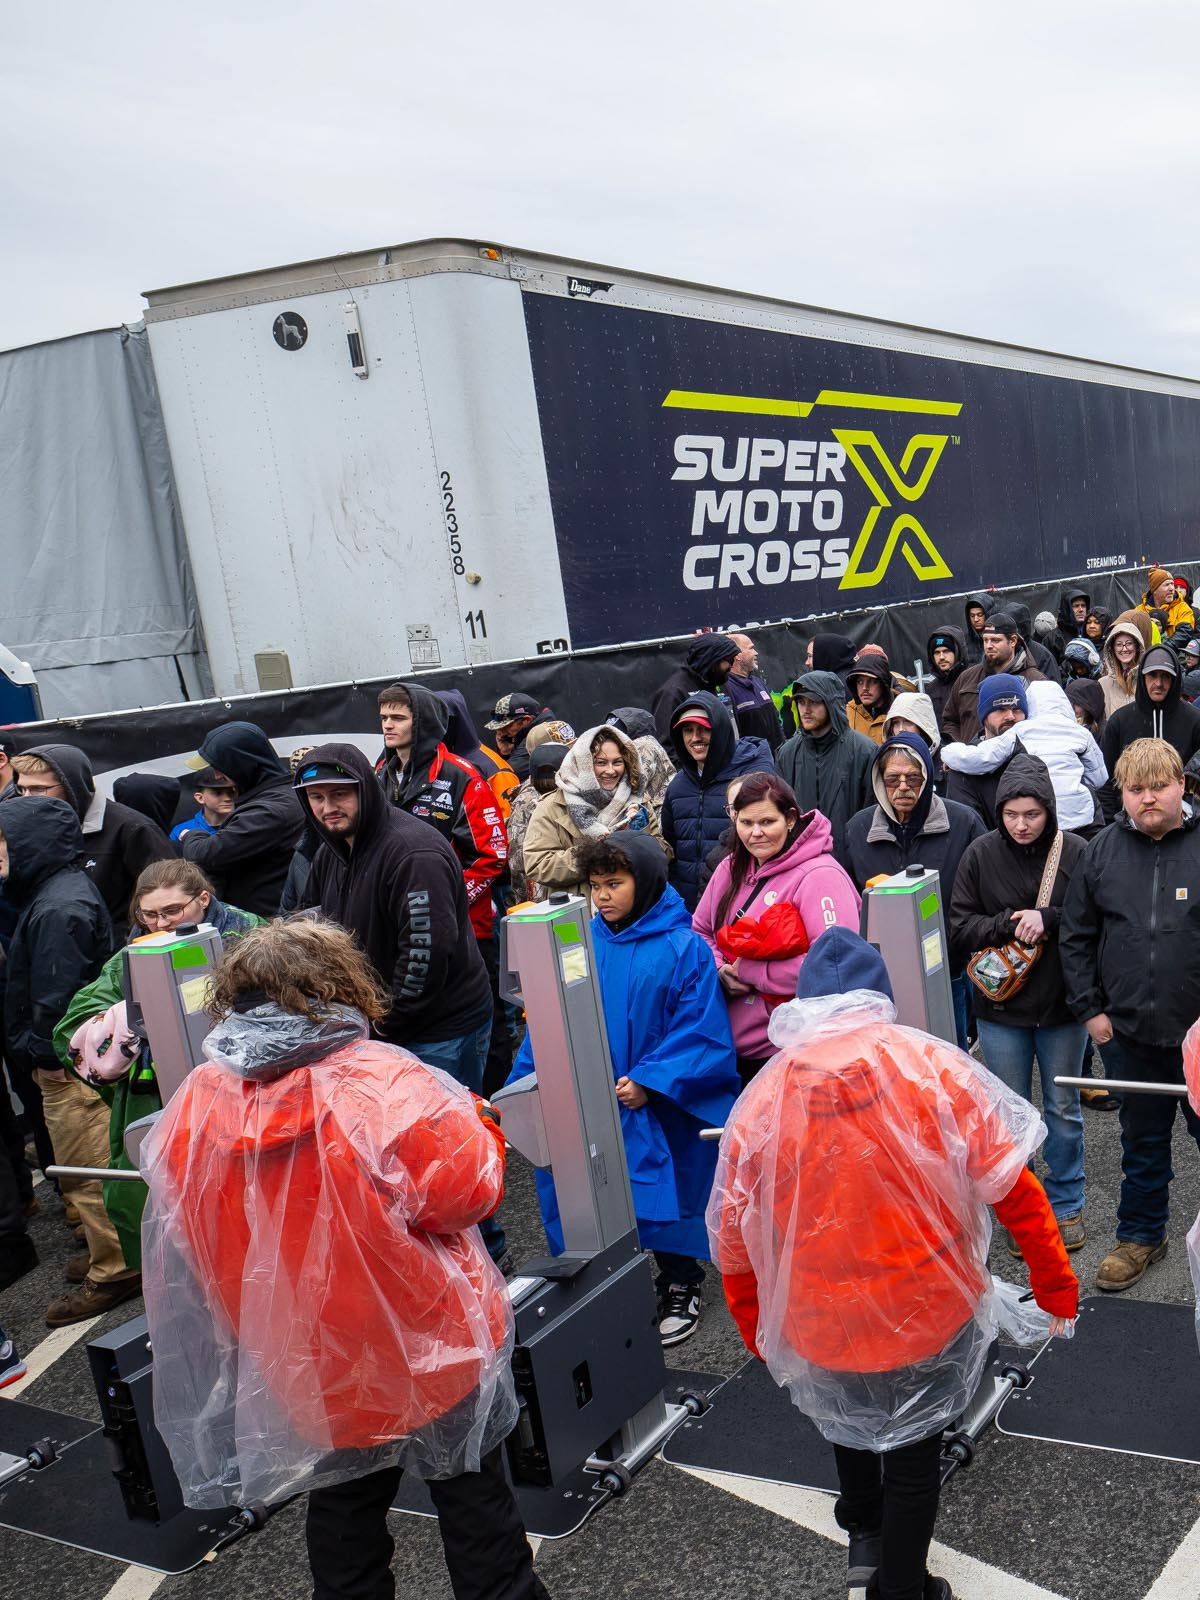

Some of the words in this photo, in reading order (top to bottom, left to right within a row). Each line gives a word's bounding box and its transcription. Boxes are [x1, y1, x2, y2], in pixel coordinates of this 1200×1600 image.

[671, 434, 847, 482] SUPER
[440, 471, 465, 575] 22358
[691, 488, 844, 536] MOTO
[683, 537, 850, 591] CROSS
[1086, 555, 1118, 569] STREAMING
[1118, 554, 1127, 565] ON
[465, 610, 487, 639] 11
[400, 890, 431, 997] RIDGECUT
